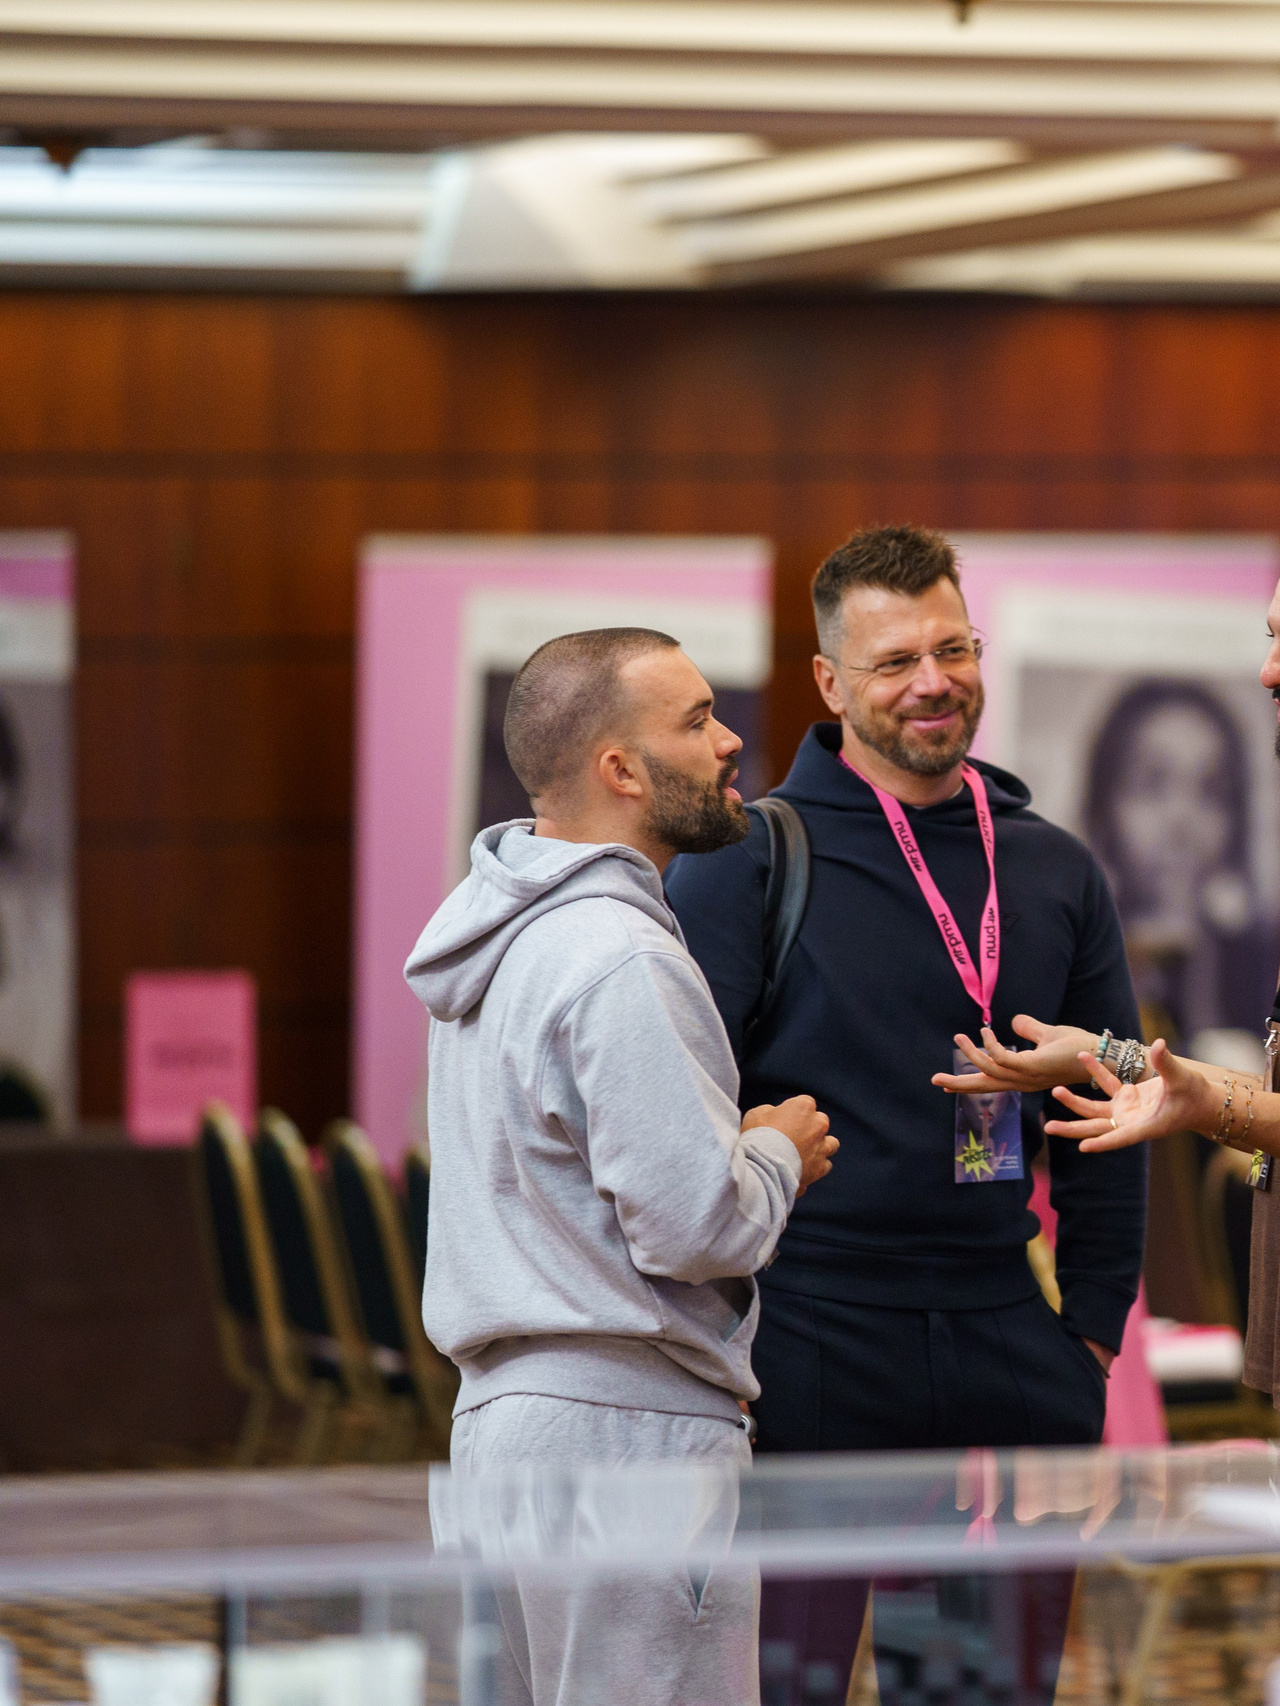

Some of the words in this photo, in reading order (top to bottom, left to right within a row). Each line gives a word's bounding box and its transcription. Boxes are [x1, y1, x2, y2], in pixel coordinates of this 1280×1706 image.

[893, 820, 922, 872] mr.pmu
[938, 912, 966, 965] mr.pmu
[984, 907, 997, 960] mr.pmu
